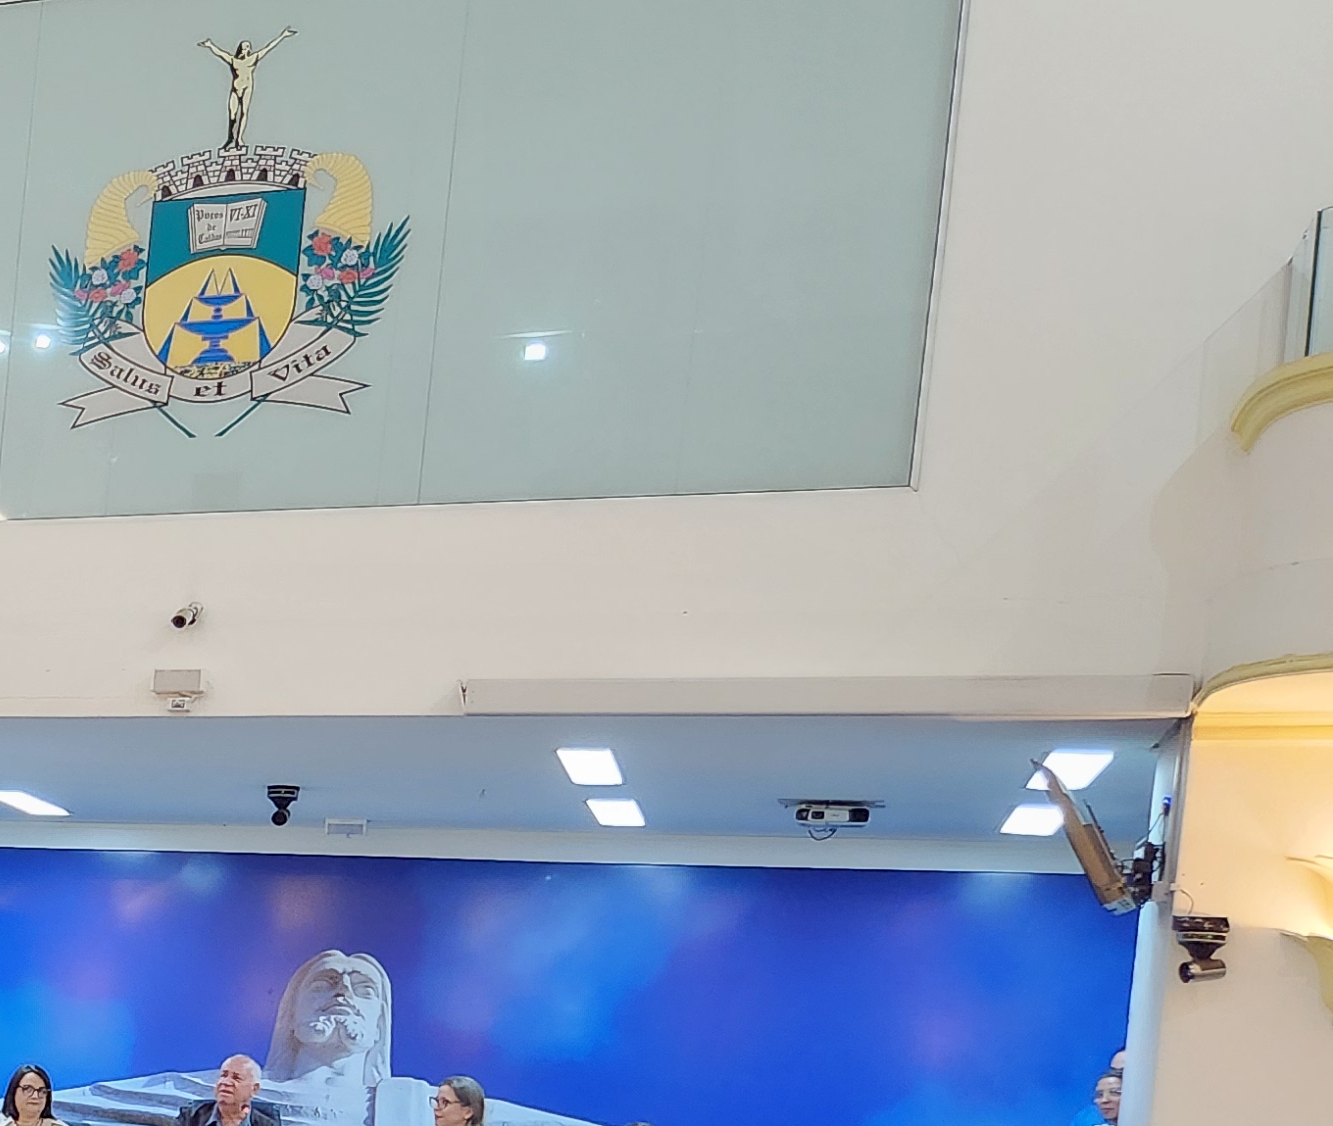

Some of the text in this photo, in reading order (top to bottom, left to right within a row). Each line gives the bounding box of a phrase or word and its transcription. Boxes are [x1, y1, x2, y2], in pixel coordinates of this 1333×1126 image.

[90, 343, 332, 397] Salus et Vita
